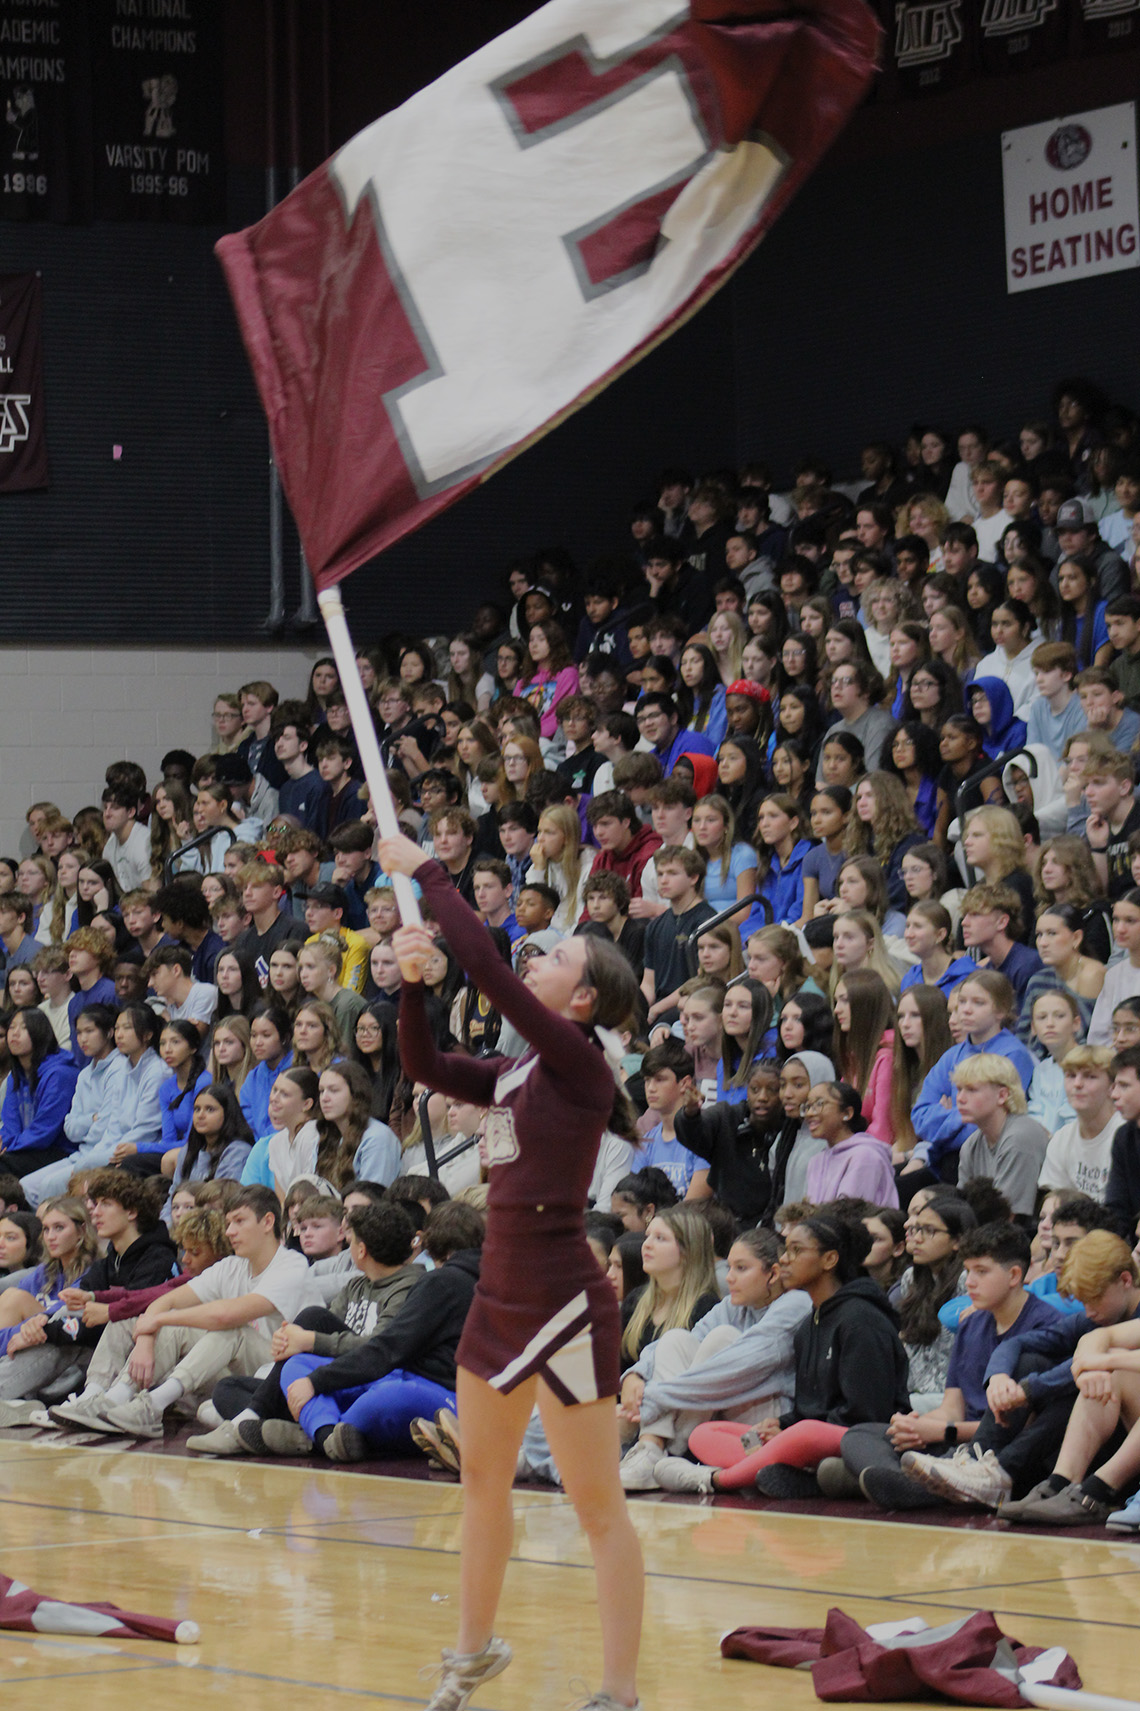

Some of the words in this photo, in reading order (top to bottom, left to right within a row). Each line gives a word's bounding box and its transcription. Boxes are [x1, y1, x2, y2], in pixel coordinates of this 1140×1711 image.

[111, 25, 196, 53] CHAMPIONS
[105, 144, 168, 170] VARSITY
[176, 150, 209, 174] POM
[1029, 177, 1113, 225] HOME
[1011, 223, 1136, 278] SEATING
